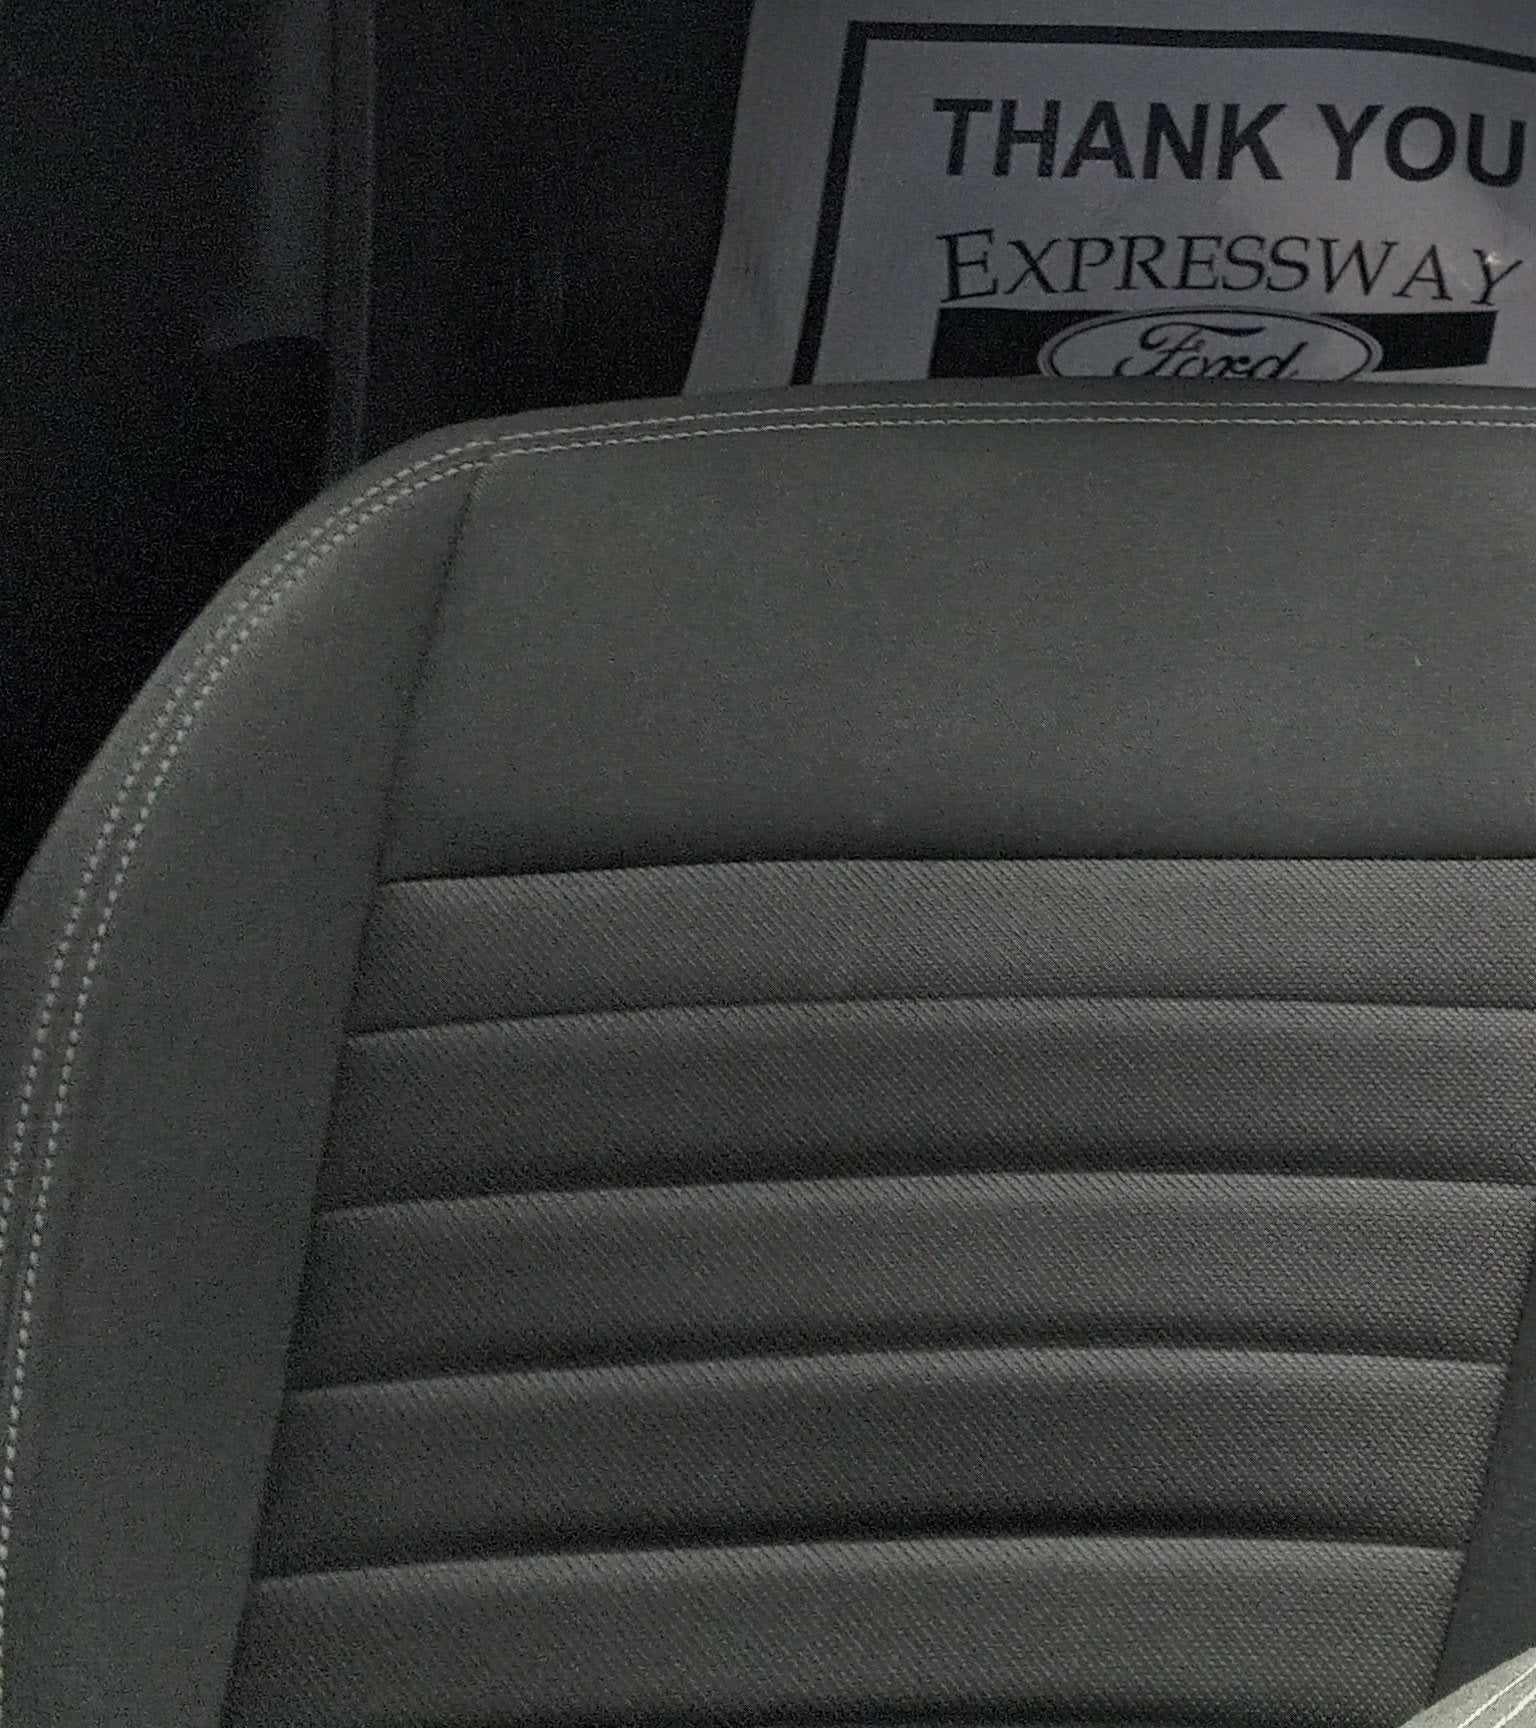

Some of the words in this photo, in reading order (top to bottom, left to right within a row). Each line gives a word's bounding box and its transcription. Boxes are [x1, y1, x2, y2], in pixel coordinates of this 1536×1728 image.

[931, 95, 1287, 182] THANK
[935, 227, 1523, 308] EXPRESSWAY
[1112, 321, 1309, 379] Ford
